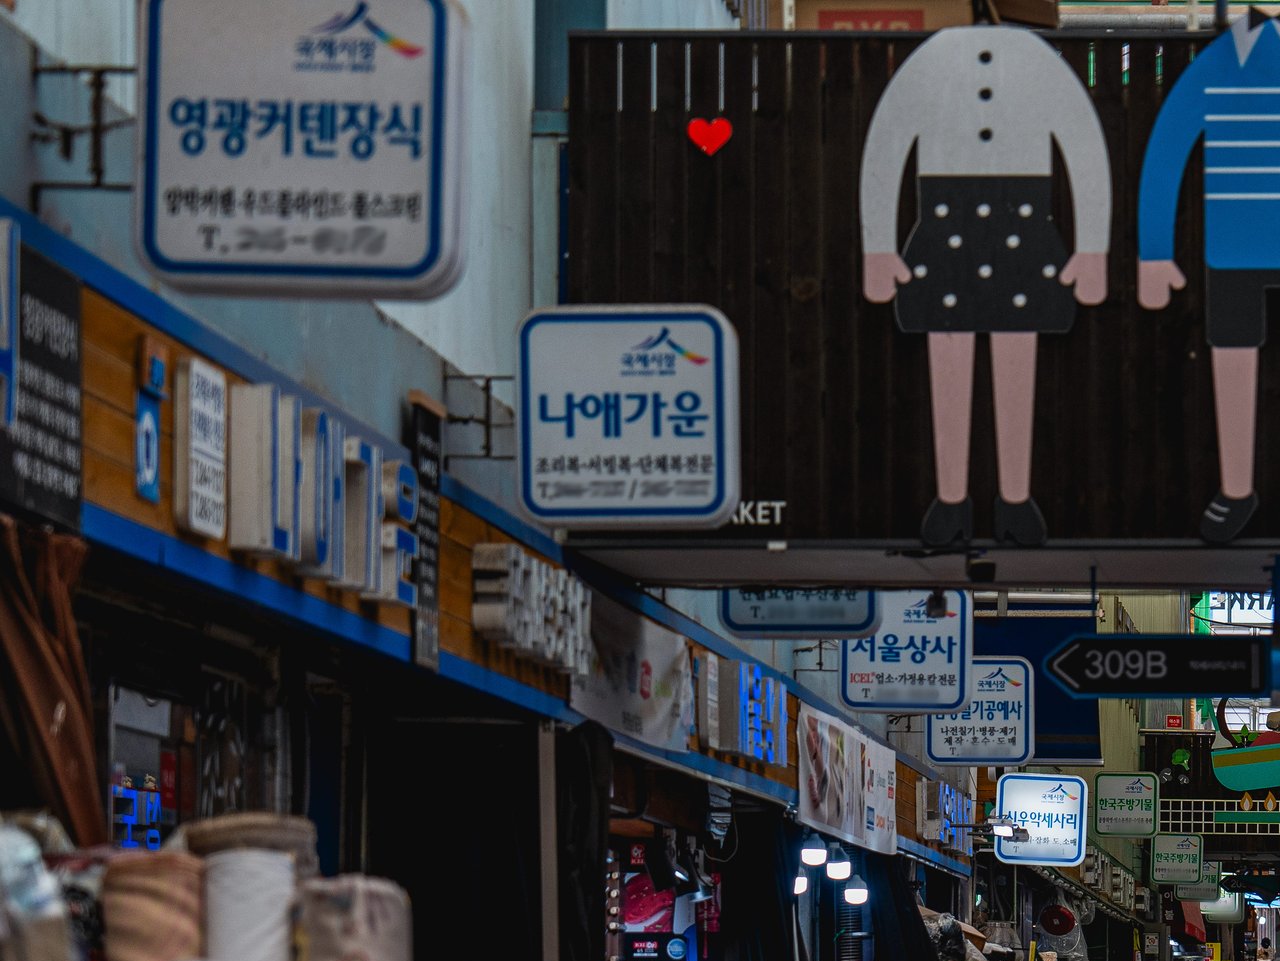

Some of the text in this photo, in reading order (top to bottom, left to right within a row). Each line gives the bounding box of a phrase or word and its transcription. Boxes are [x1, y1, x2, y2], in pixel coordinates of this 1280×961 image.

[297, 39, 376, 59] 국제시장
[168, 98, 422, 160] 영광커텐장식
[620, 353, 676, 369] 국제시장
[538, 391, 709, 438] 나애가운
[851, 634, 957, 664] 서울상사
[1084, 649, 1168, 679] 309B
[978, 680, 1005, 689] 국제시장
[1099, 798, 1152, 811] 한국주방기물
[1155, 853, 1198, 864] 한국주방기물
